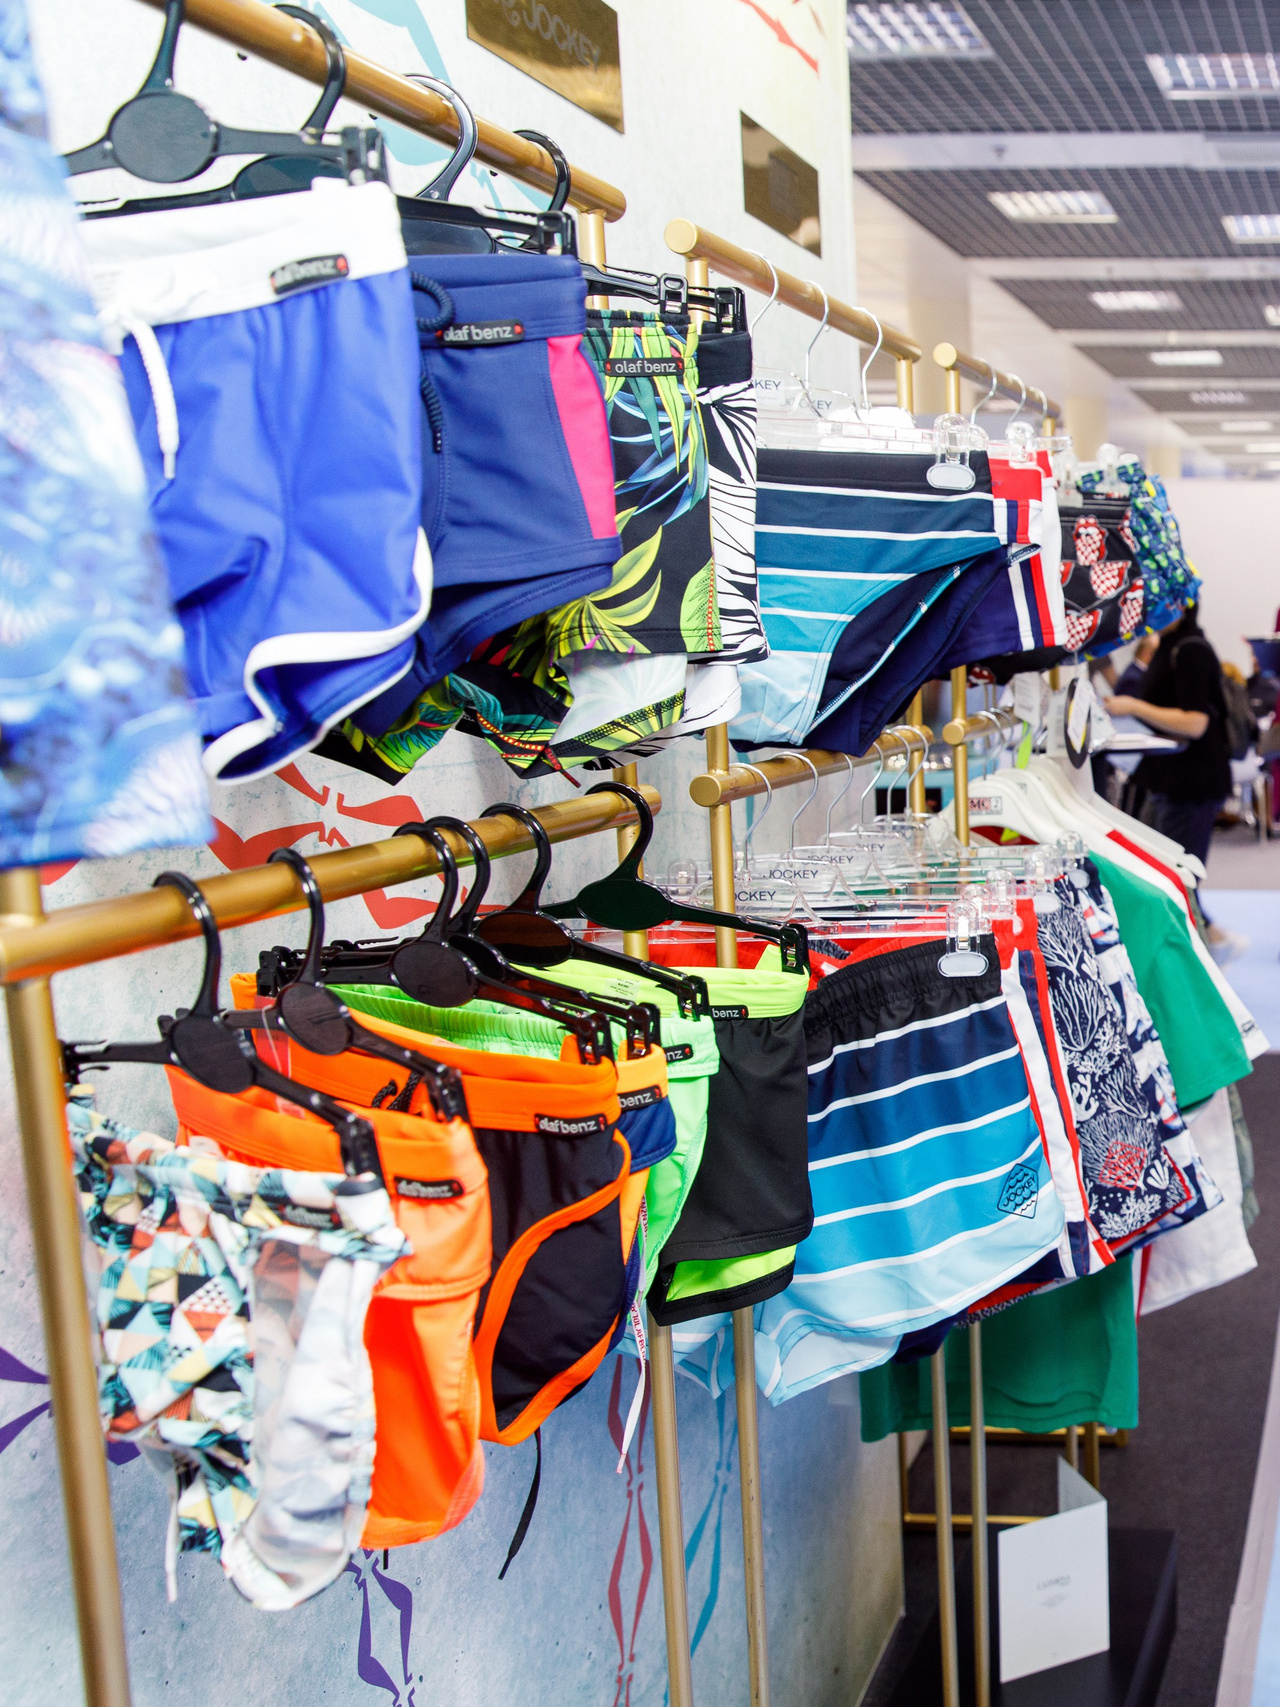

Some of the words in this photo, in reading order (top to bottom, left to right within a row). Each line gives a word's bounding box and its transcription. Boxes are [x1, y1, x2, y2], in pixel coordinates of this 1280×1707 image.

[443, 325, 470, 342] olaf
[469, 324, 514, 341] benz
[614, 360, 643, 374] olaf
[643, 360, 677, 374] benz
[767, 868, 819, 880] JOCKEY
[711, 1007, 740, 1019] benz
[618, 1092, 653, 1109] benz
[539, 1117, 561, 1133] olaf
[559, 1120, 598, 1134] benz
[1002, 1174, 1036, 1207] JOCKEY
